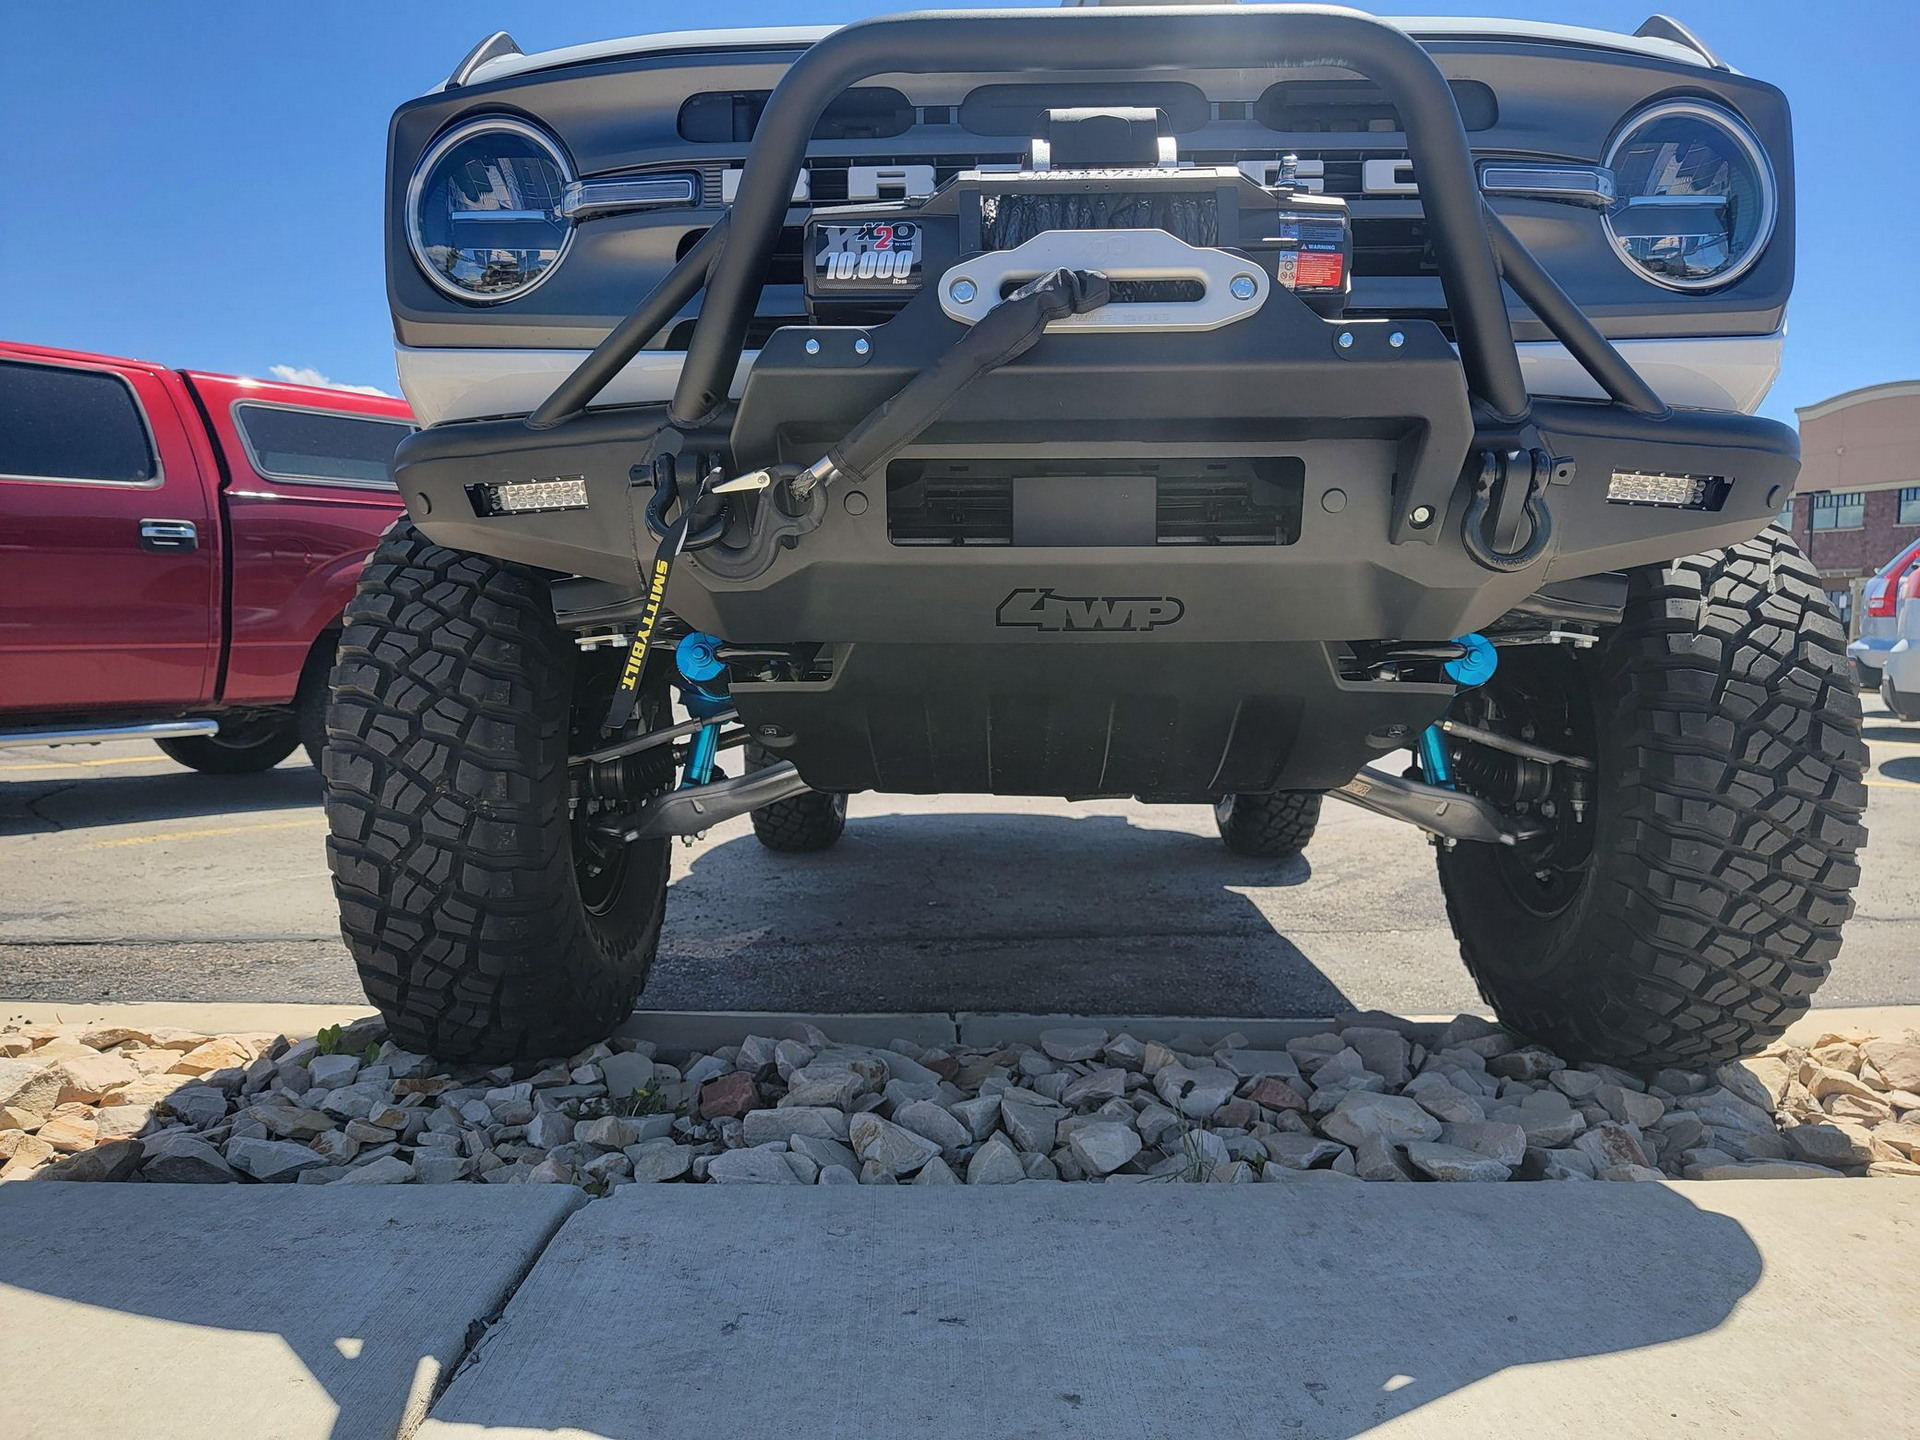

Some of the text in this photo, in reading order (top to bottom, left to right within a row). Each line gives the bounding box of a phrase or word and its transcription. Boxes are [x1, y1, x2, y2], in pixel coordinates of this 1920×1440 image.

[826, 250, 914, 279] 10,000
[622, 559, 668, 691] SMITTYBILT
[996, 588, 1185, 631] 4WP
